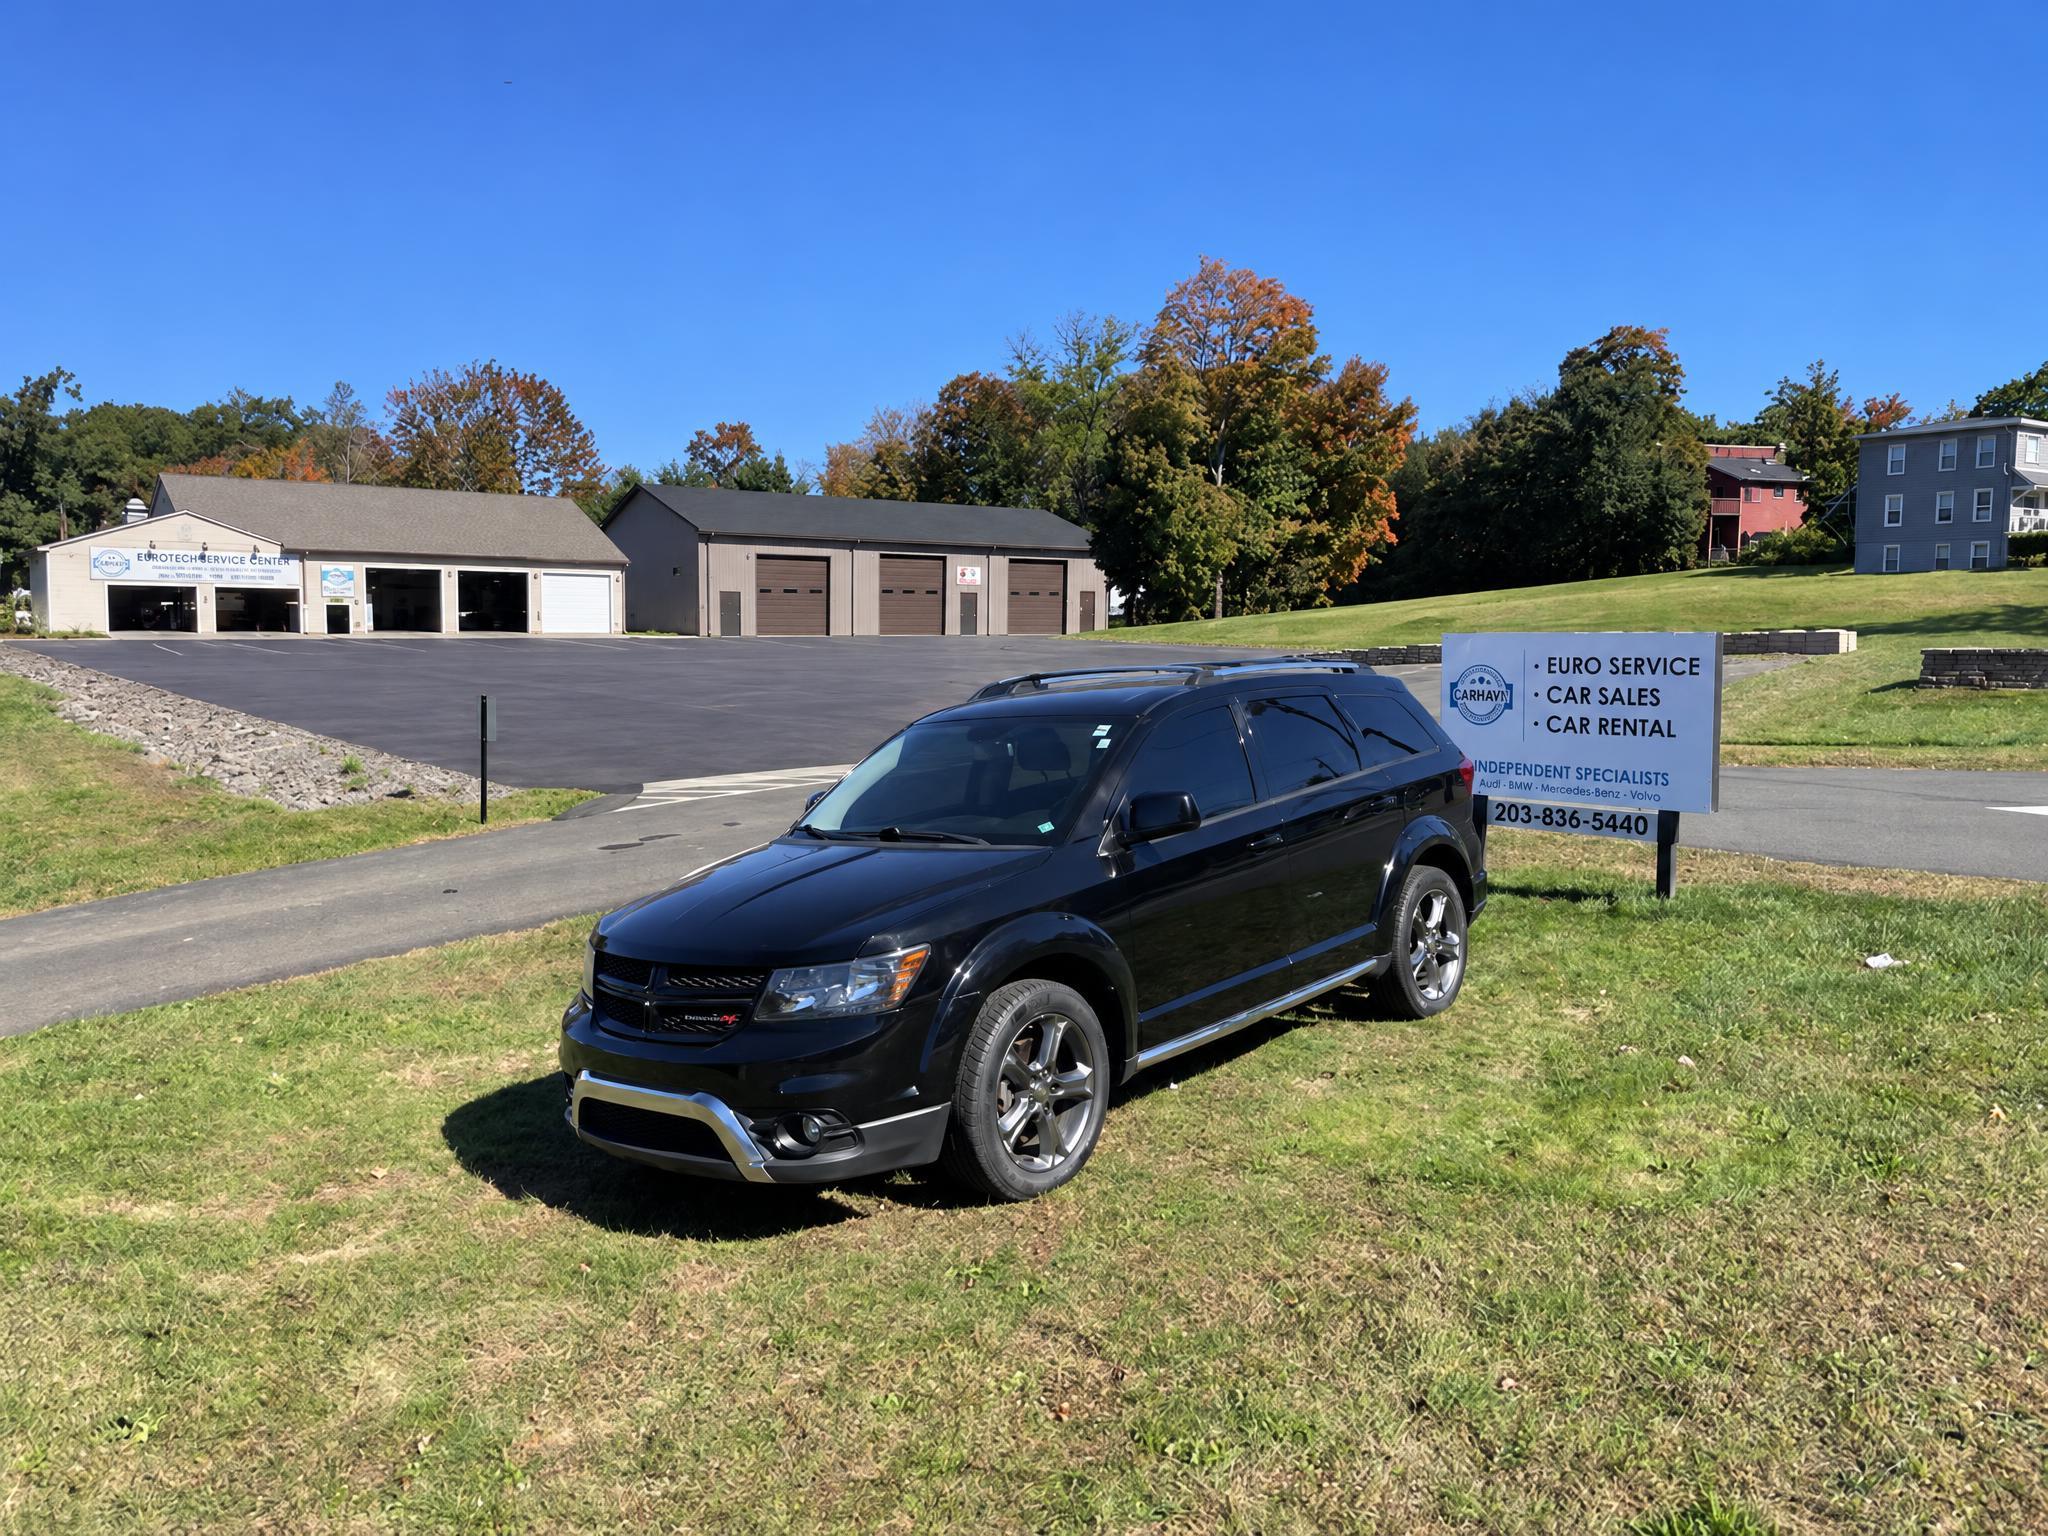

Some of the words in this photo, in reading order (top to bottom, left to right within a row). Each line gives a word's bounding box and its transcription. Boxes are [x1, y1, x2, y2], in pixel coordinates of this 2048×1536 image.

[137, 552, 197, 563] EUROTECH
[250, 556, 290, 566] CENTER
[1547, 656, 1602, 675] EURO
[1609, 656, 1700, 676] SERVICE
[1454, 688, 1509, 702] CARHAVN
[1546, 685, 1591, 705] CAR
[1598, 687, 1661, 707] SALES
[1546, 715, 1590, 735] CAR
[1598, 717, 1677, 738] RENTAL
[1474, 760, 1571, 780] INDEPENDENT
[1575, 766, 1670, 787] SPECIALISTS
[1480, 779, 1501, 789] Audi
[1508, 780, 1534, 791] BMW
[1540, 783, 1621, 799] Mercedes-Benz
[1630, 790, 1662, 802] Volvo
[1494, 802, 1649, 836] 203-836-5440
